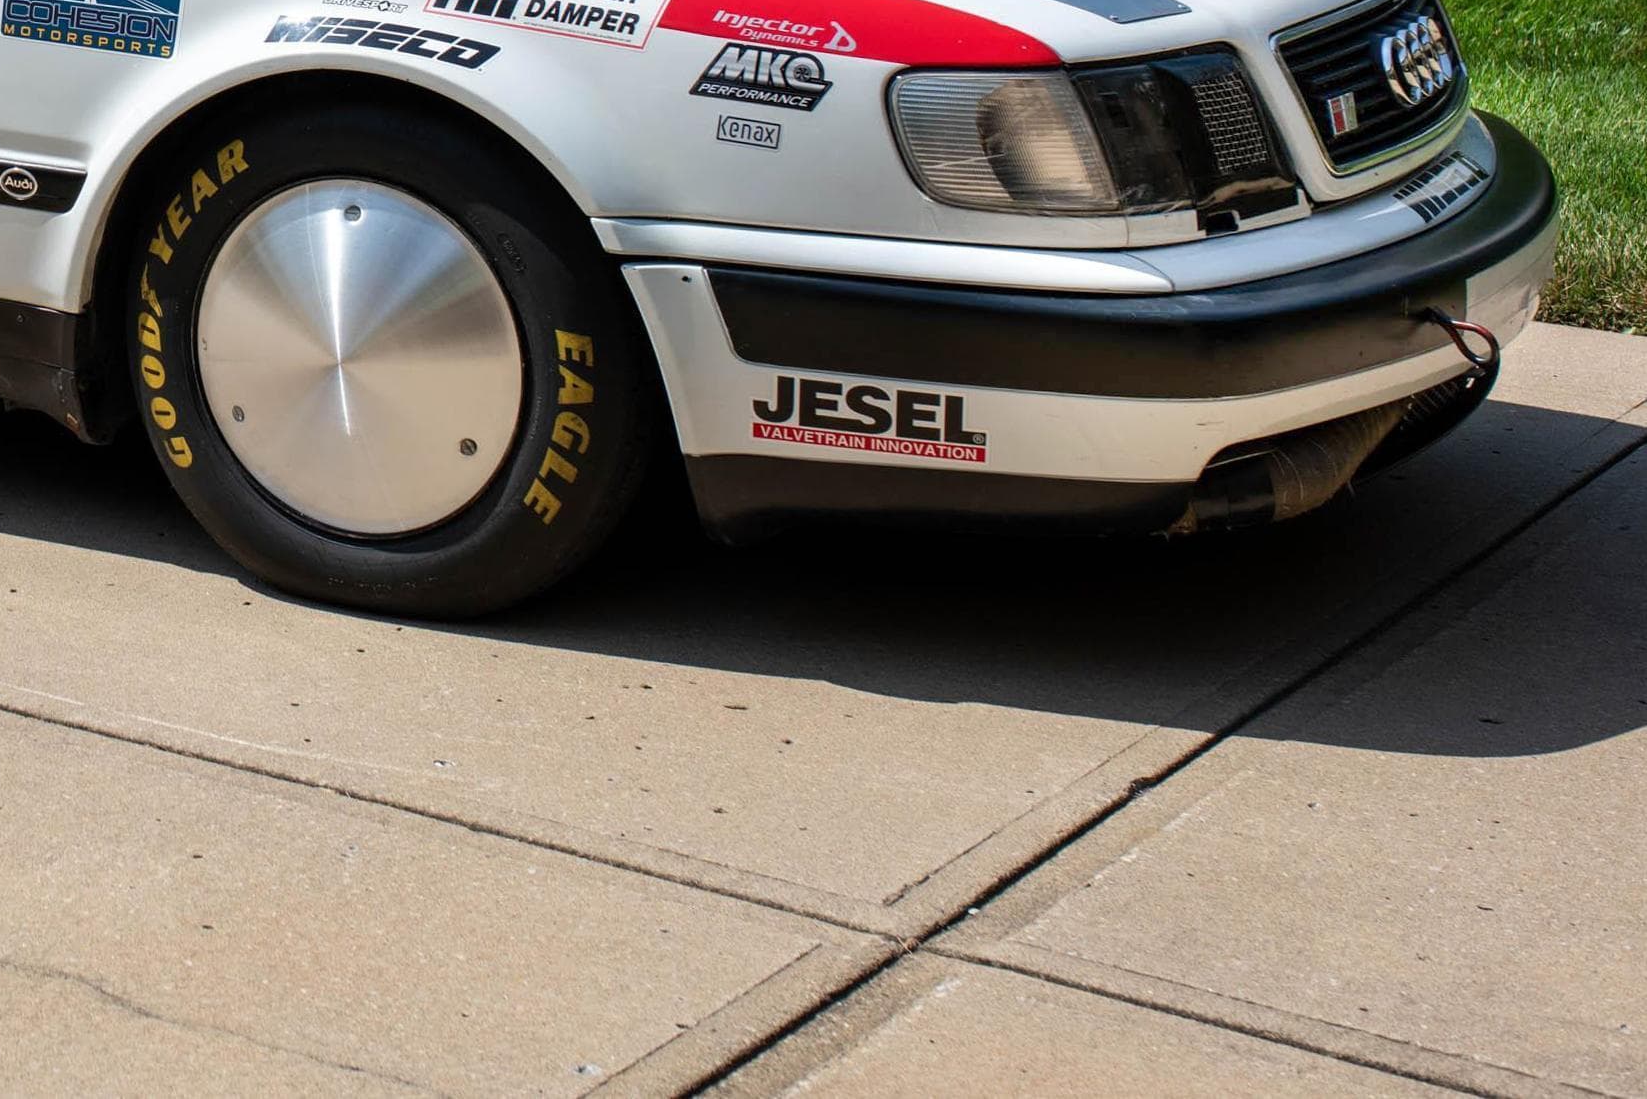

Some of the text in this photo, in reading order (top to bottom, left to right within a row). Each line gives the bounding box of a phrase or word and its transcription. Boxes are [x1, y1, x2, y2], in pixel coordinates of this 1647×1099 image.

[3, 23, 171, 57] MOTORSPORTS
[712, 9, 825, 37] Injector
[697, 83, 813, 108] PERFORMANCE
[4, 175, 34, 191] Audi
[523, 329, 595, 526] EAGLE
[752, 375, 986, 446] JESEL
[760, 424, 978, 461] VALVETRAIN INNOVATION
